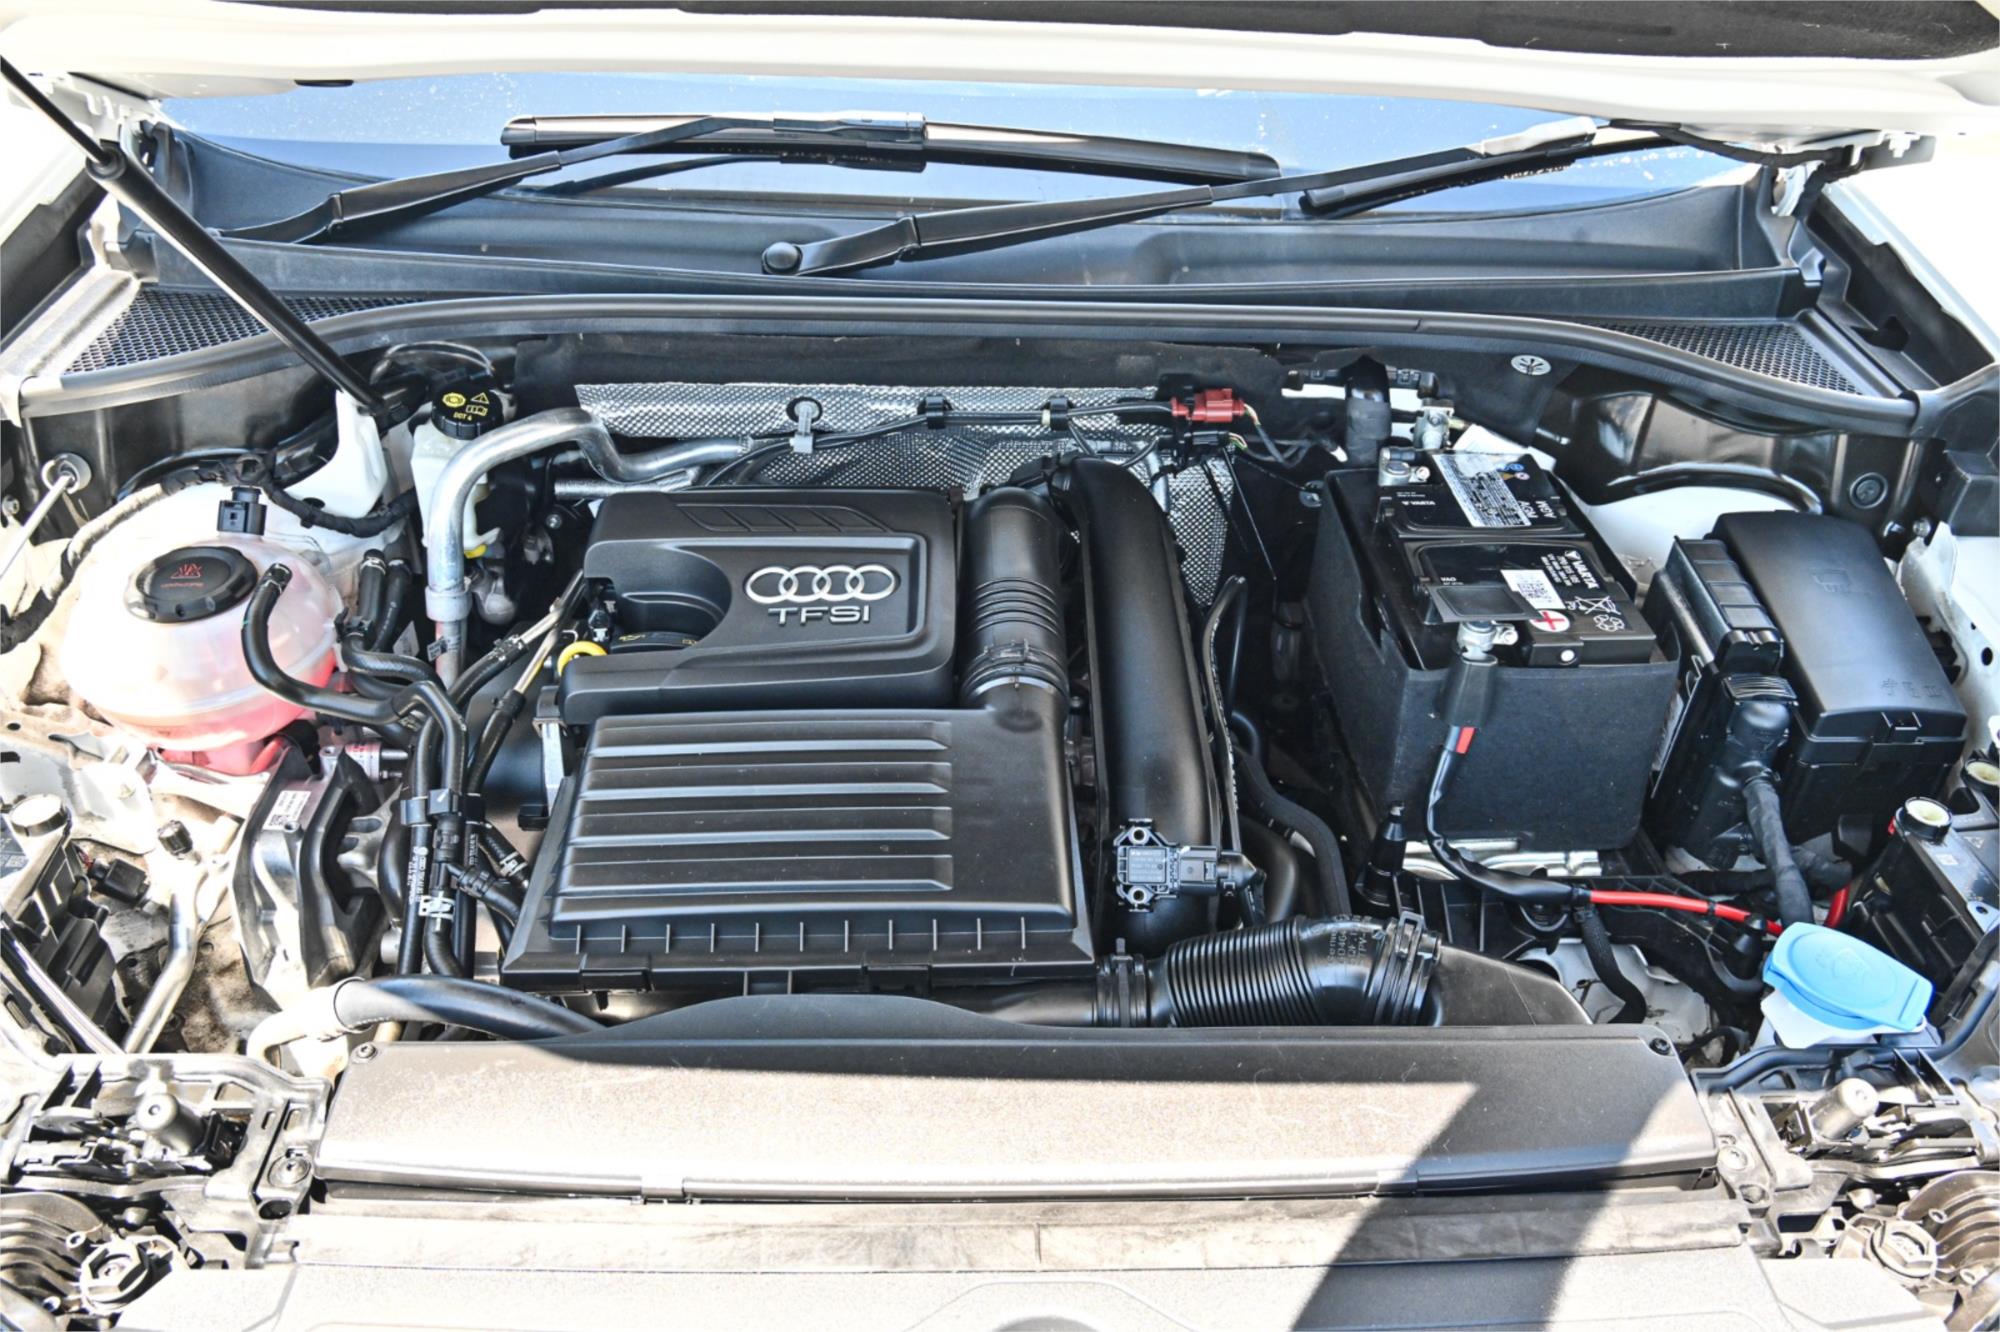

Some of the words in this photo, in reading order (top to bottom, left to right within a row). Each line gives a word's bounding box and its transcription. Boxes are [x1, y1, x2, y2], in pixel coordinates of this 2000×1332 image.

[1535, 500, 1557, 518] AGM
[1571, 560, 1600, 589] VARTA
[767, 605, 870, 626] TFSI
